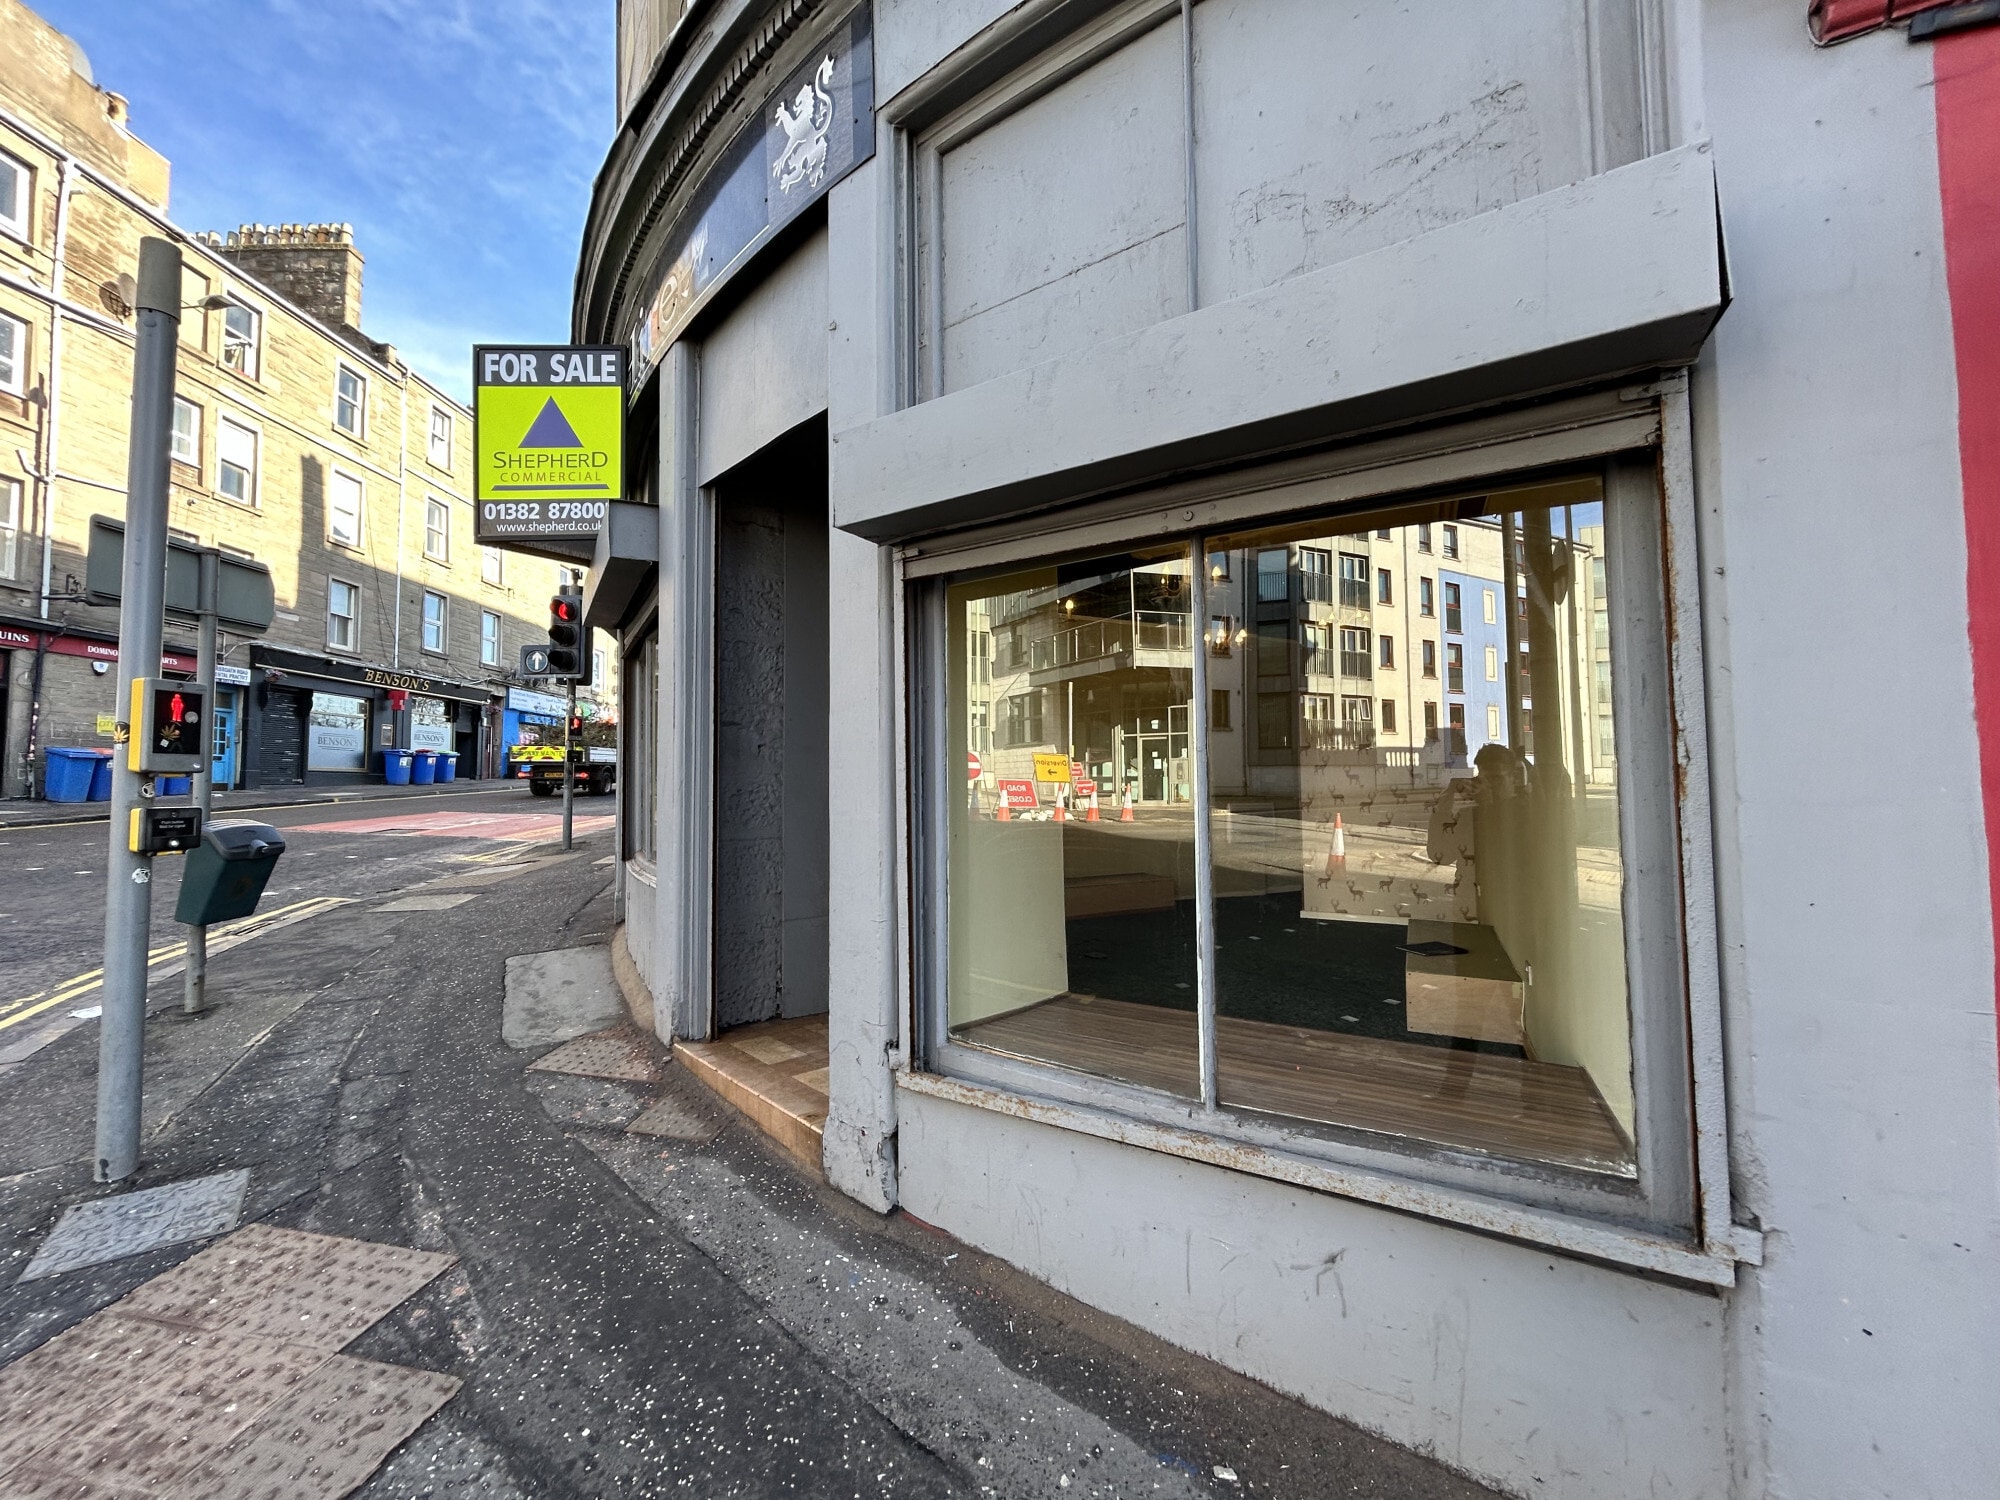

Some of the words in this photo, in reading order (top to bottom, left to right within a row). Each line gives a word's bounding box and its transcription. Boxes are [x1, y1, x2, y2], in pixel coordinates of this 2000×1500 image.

[484, 353, 538, 383] FOR
[549, 353, 616, 383] SALE
[493, 451, 608, 469] SHEPHERD
[500, 471, 602, 482] COMMERCIAL
[484, 502, 540, 520] 01382
[548, 502, 609, 519] 87800
[364, 669, 431, 691] BENSON'S
